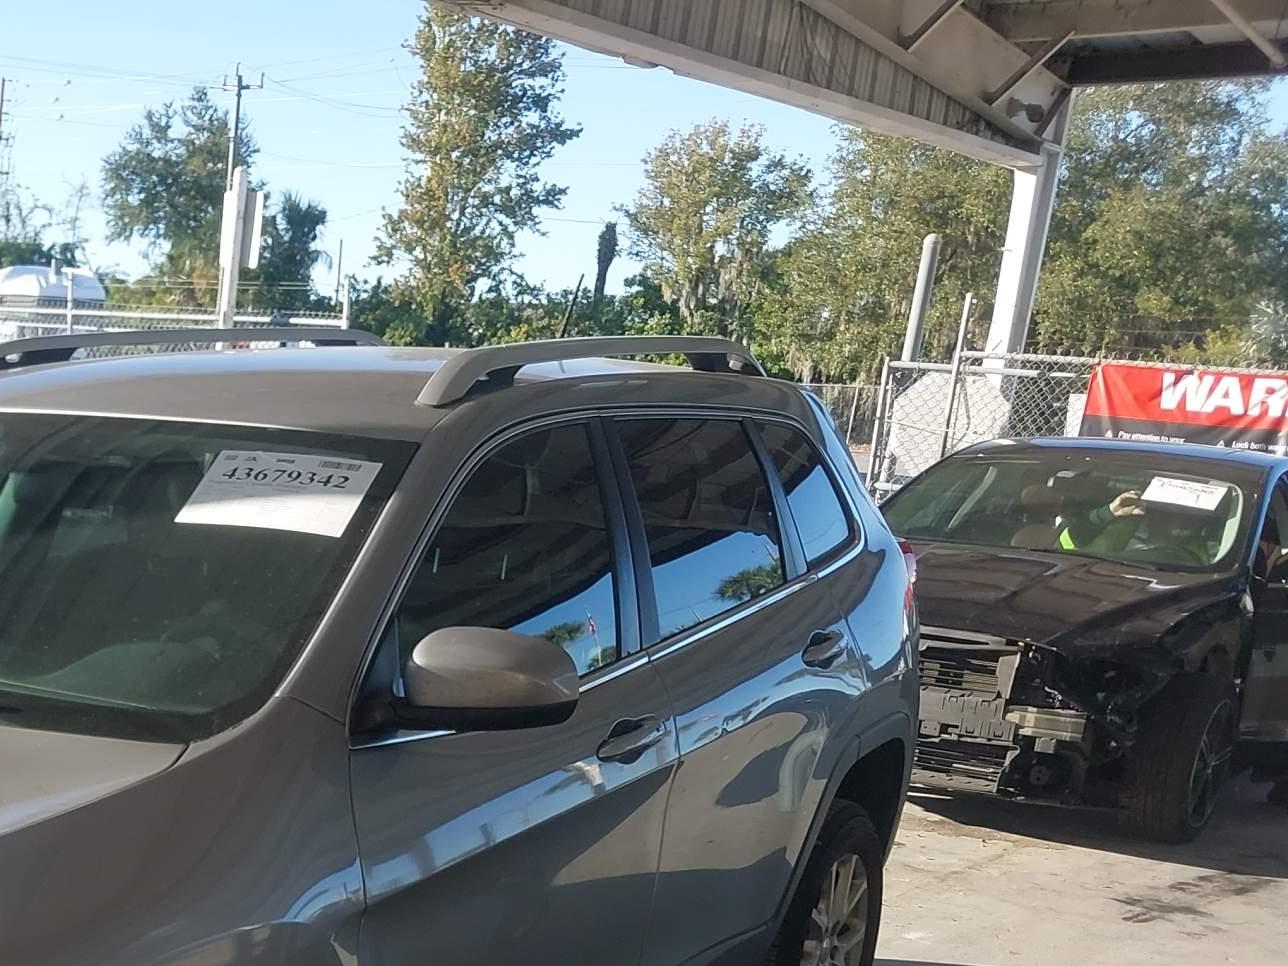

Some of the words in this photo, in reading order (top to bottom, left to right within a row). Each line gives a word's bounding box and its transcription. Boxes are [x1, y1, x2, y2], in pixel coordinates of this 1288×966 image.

[1160, 372, 1288, 416] WAR
[1232, 440, 1249, 449] Look
[222, 466, 350, 489] 43679342
